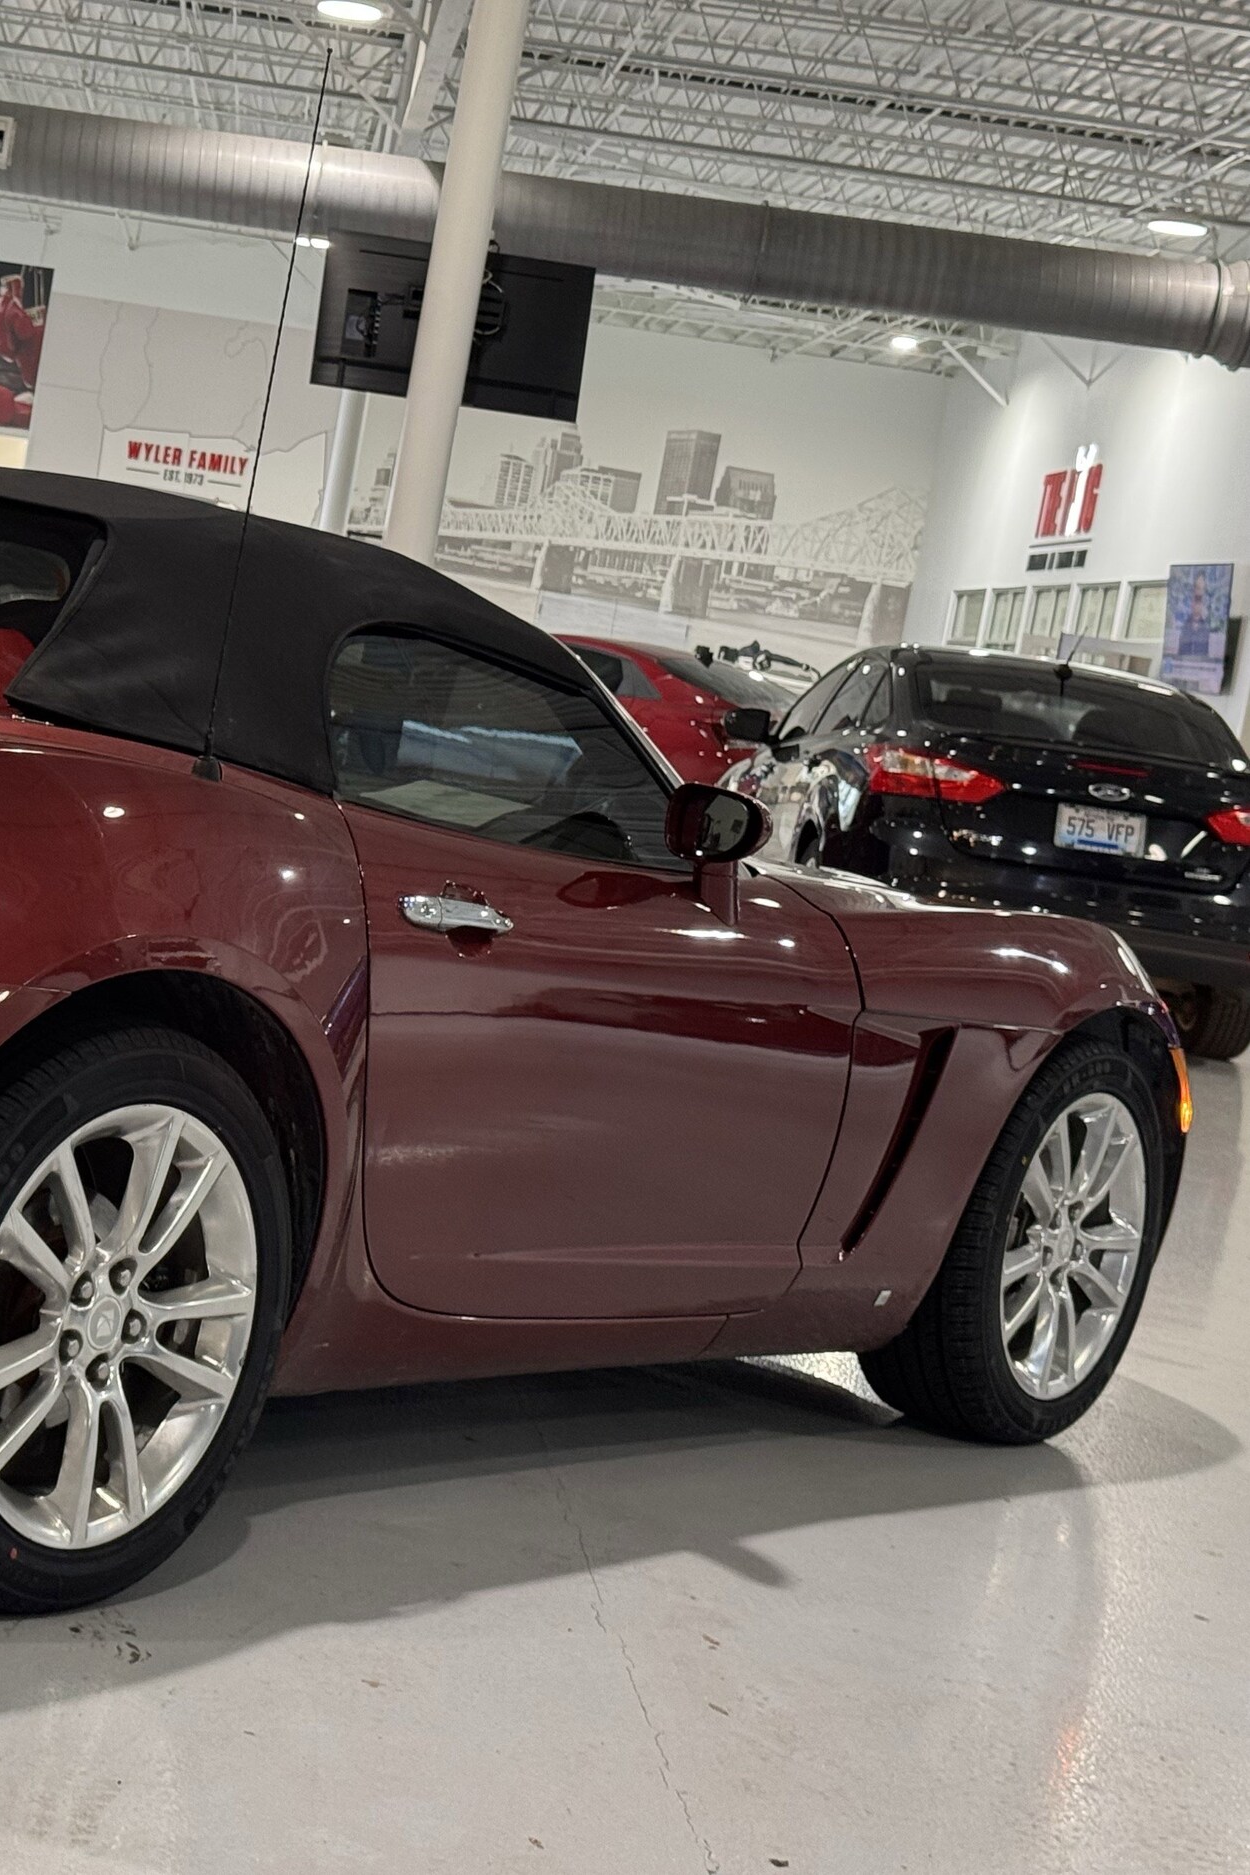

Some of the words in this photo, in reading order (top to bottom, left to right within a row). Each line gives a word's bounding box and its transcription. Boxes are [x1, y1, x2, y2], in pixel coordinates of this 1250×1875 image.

[127, 440, 183, 466] WYLER
[188, 449, 249, 476] FAMILY
[163, 468, 180, 483] EST.
[183, 471, 204, 486] 1973
[1066, 816, 1095, 838] 575
[1107, 822, 1135, 843] VFP
